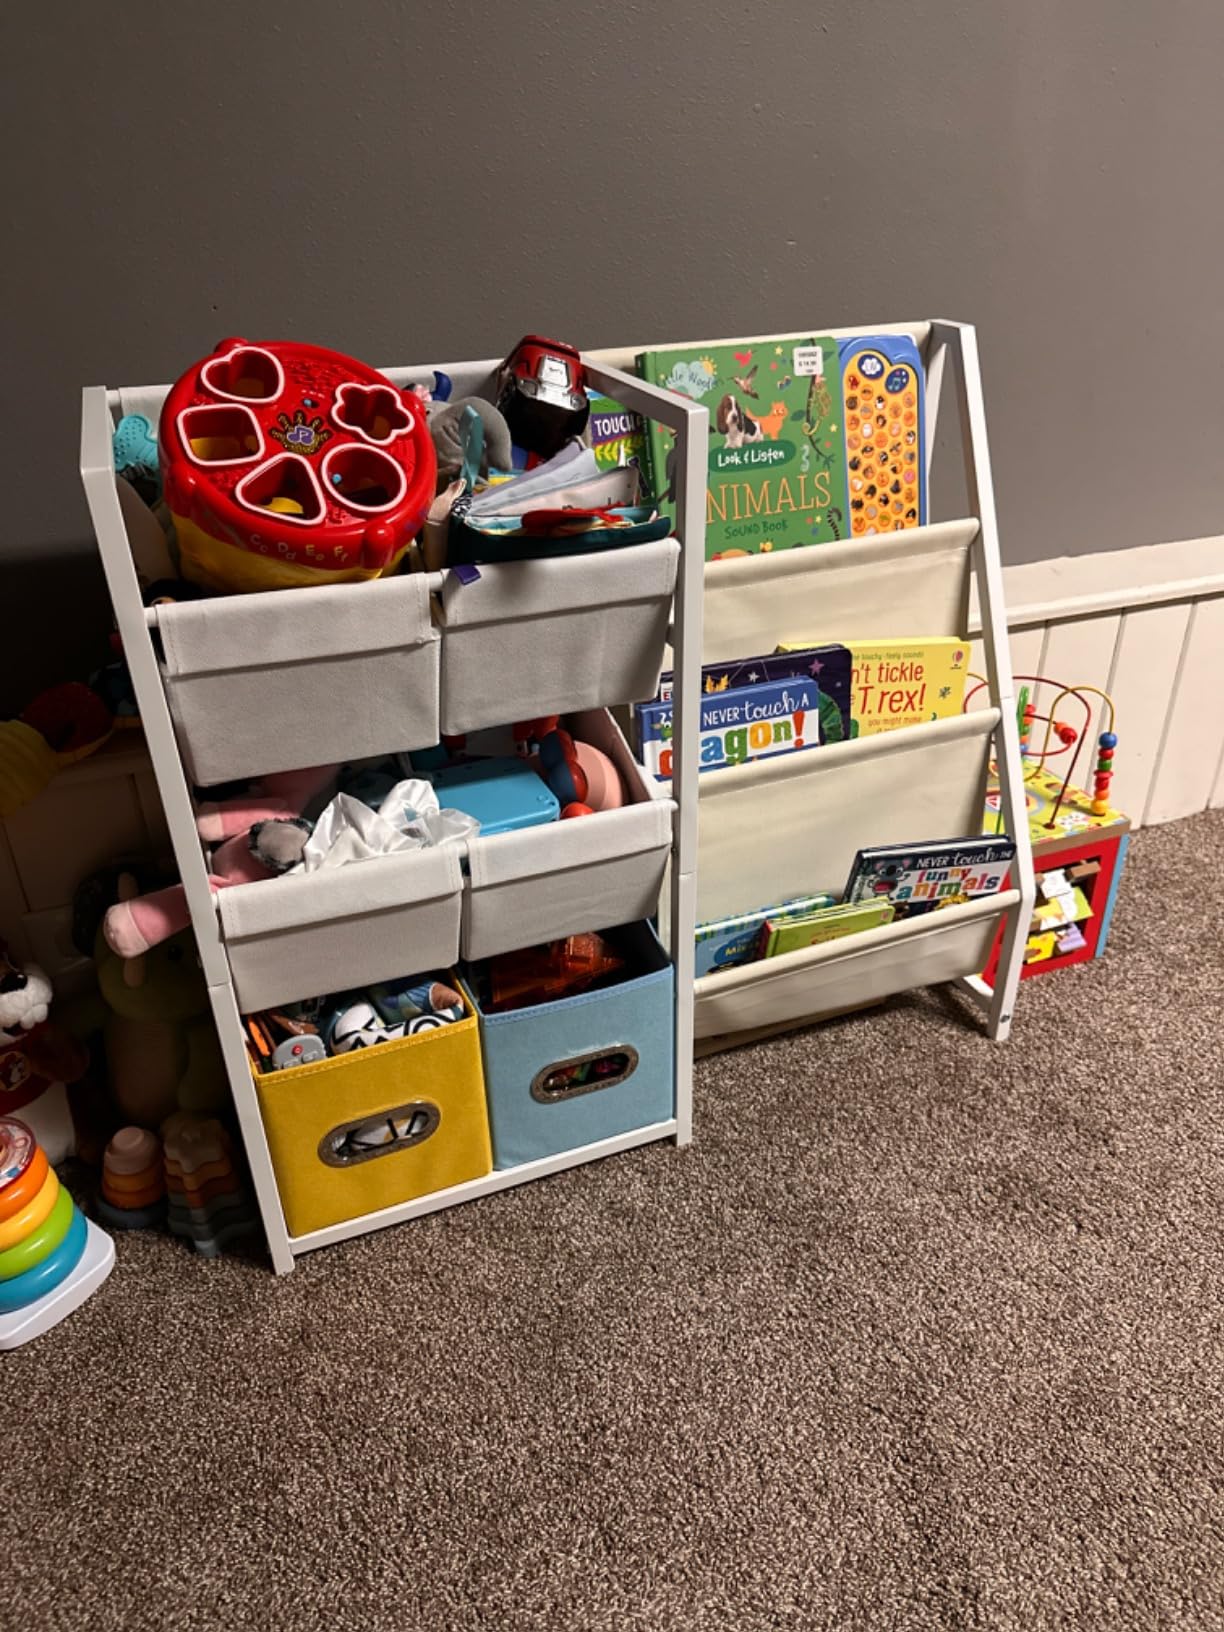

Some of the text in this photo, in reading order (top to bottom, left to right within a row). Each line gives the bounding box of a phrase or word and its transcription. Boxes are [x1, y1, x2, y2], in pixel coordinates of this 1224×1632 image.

[595, 415, 635, 437] TOUCH
[718, 452, 743, 467] Look
[751, 447, 785, 465] Listen
[705, 471, 832, 524] NIMALS
[851, 661, 925, 684] n't tickle
[703, 690, 810, 727] NEVER touch A
[916, 855, 950, 869] NEVER
[950, 847, 998, 867] touch
[896, 872, 1001, 901] animals
[917, 867, 973, 884] funny
